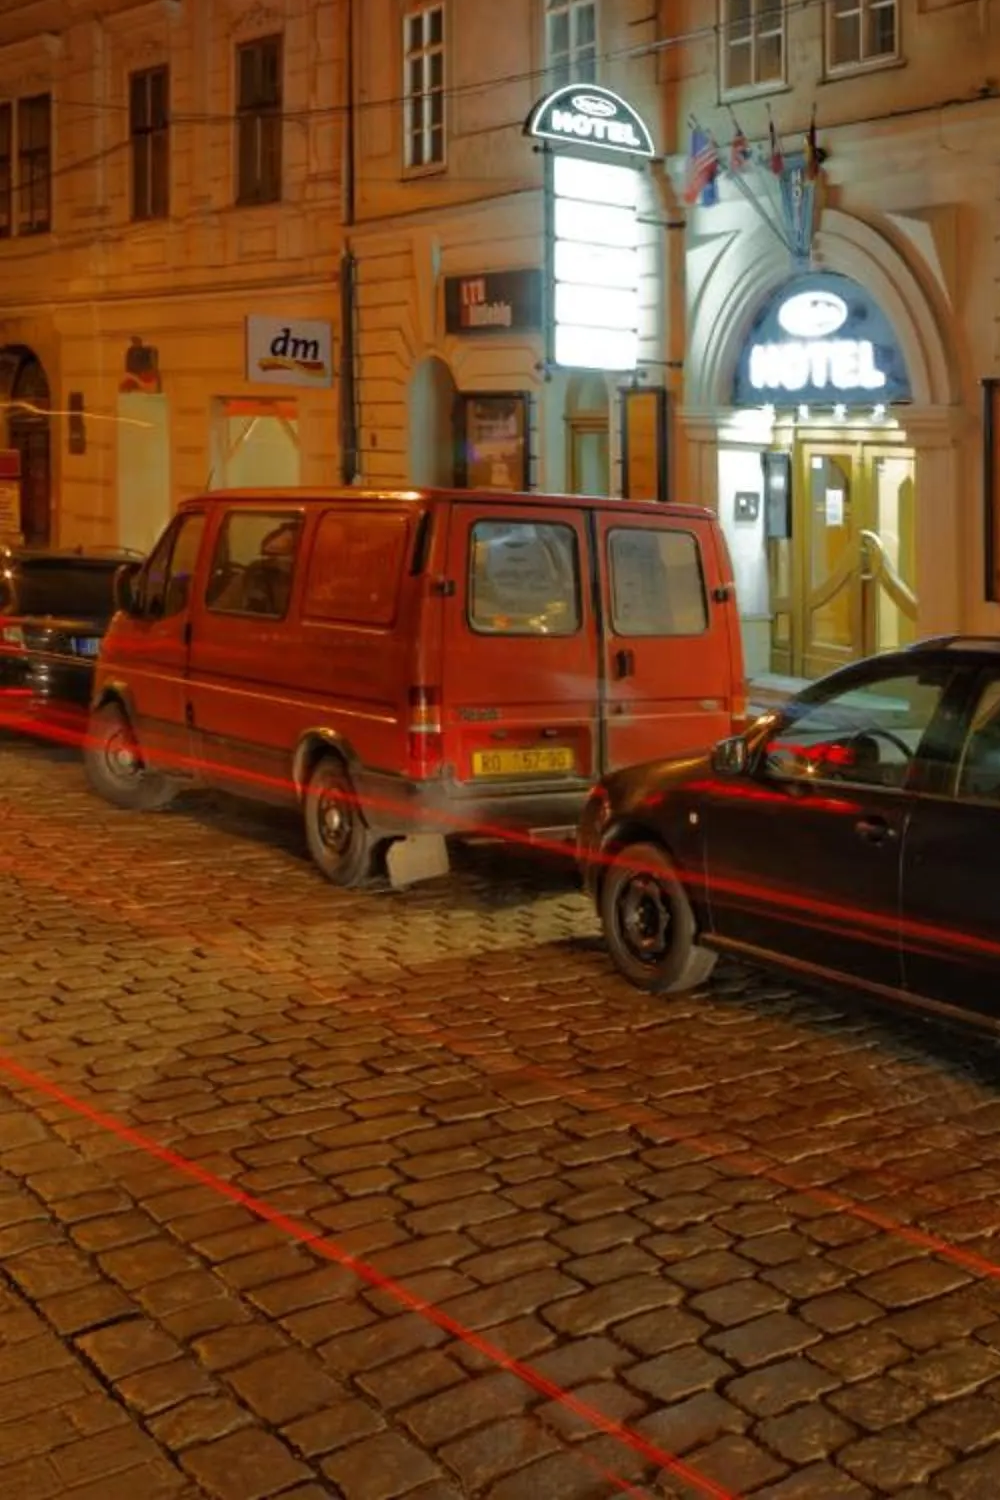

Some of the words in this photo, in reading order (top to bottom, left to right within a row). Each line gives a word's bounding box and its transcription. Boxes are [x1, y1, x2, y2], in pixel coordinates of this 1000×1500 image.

[551, 109, 640, 146] HOTEL
[270, 327, 319, 360] dm
[750, 339, 886, 390] HOTEL
